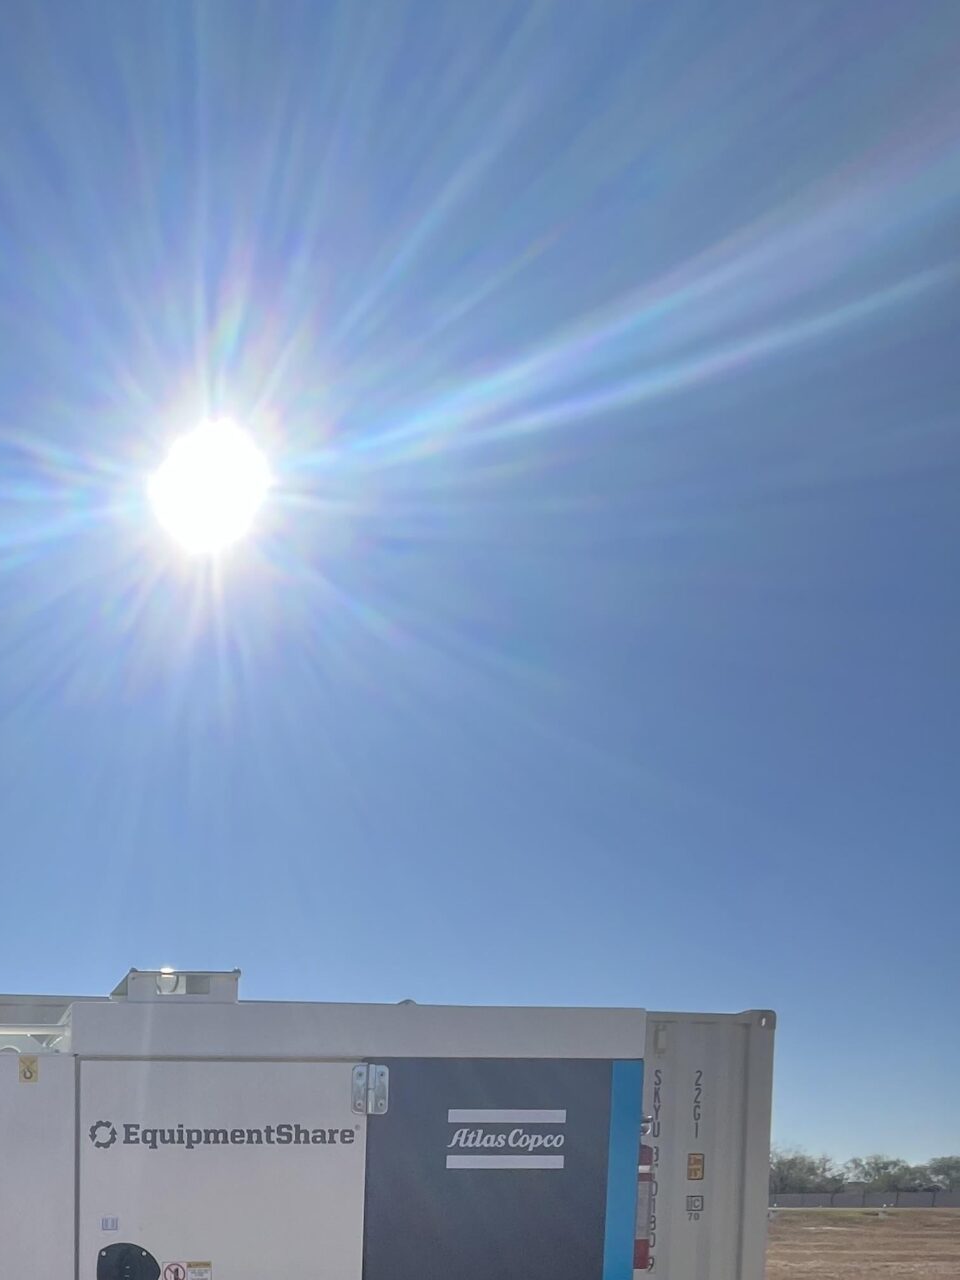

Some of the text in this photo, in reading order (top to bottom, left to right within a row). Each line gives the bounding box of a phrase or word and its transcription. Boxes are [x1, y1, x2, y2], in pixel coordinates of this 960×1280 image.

[653, 1069, 661, 1138] SKYU
[122, 1123, 356, 1149] EquipmentShare
[446, 1128, 565, 1152] Atlas Copco
